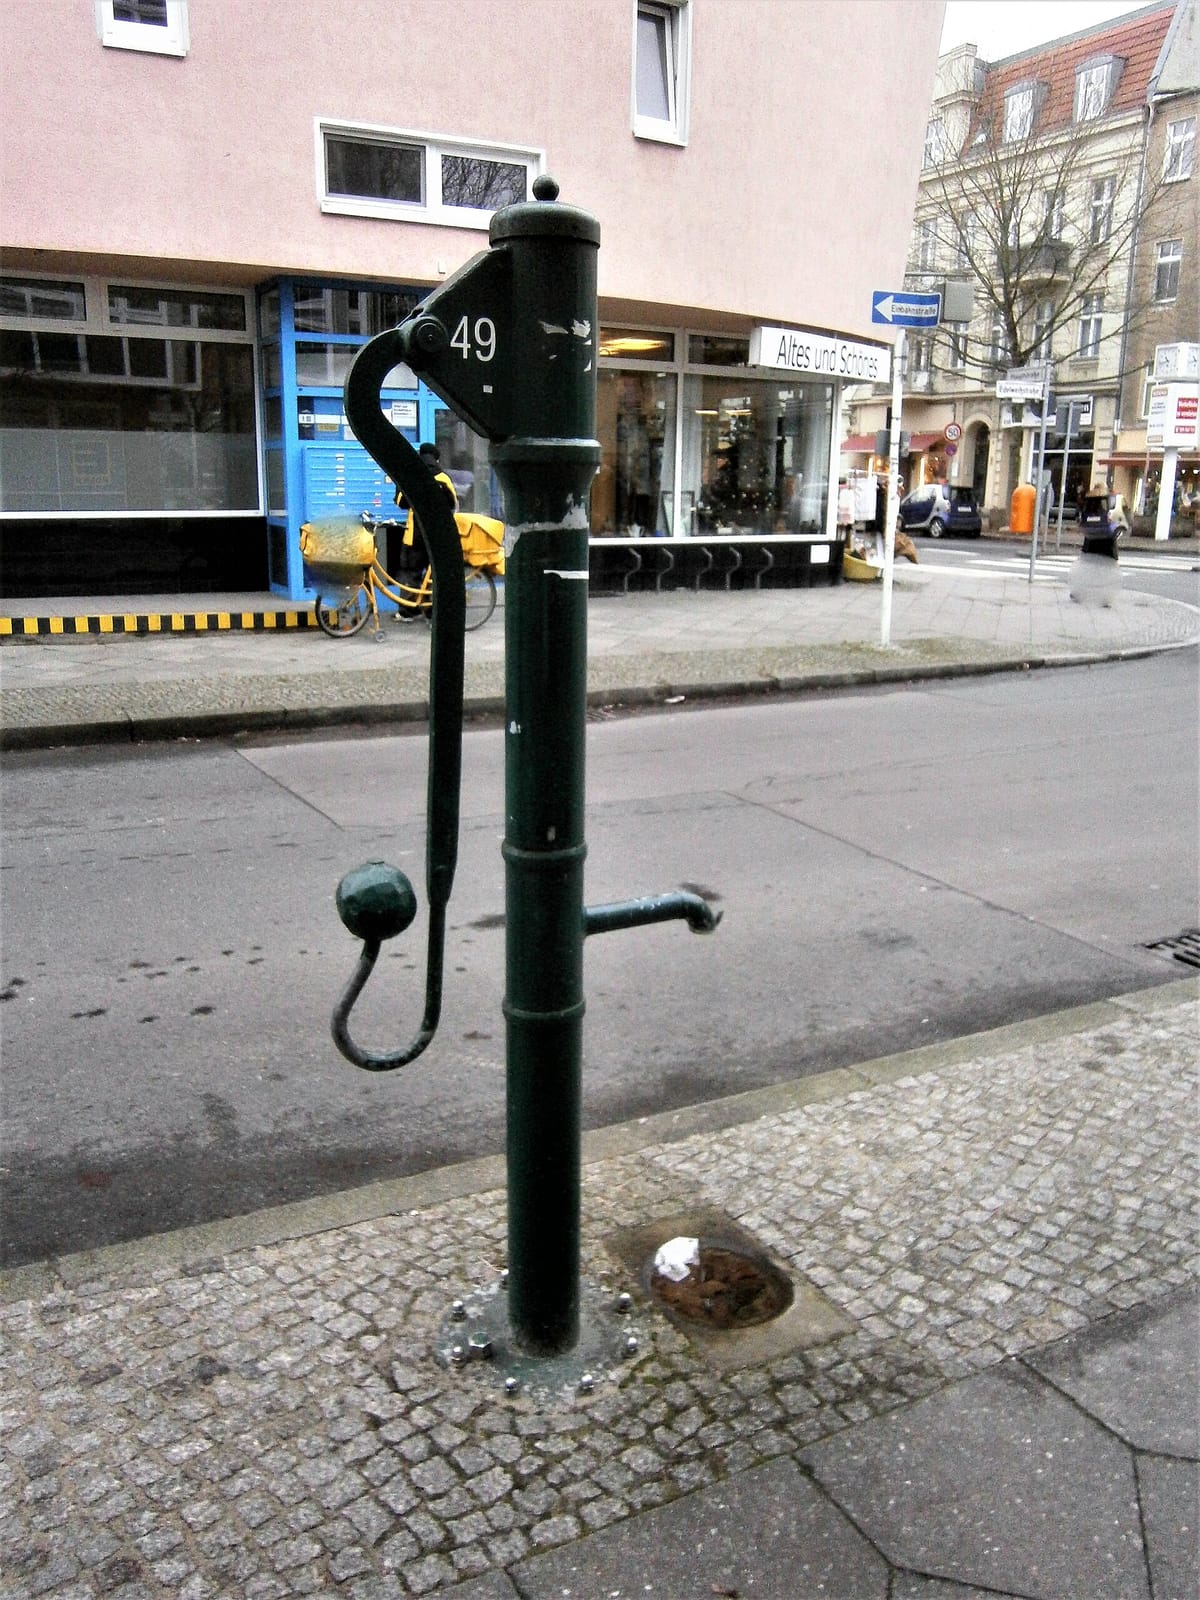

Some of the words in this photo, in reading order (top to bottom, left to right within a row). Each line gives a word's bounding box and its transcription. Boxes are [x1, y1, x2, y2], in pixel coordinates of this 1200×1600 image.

[891, 304, 937, 315] Einbahnstraße
[450, 315, 497, 362] 49
[776, 335, 811, 369] Altes
[814, 343, 837, 372] und
[840, 345, 879, 379] Schönes
